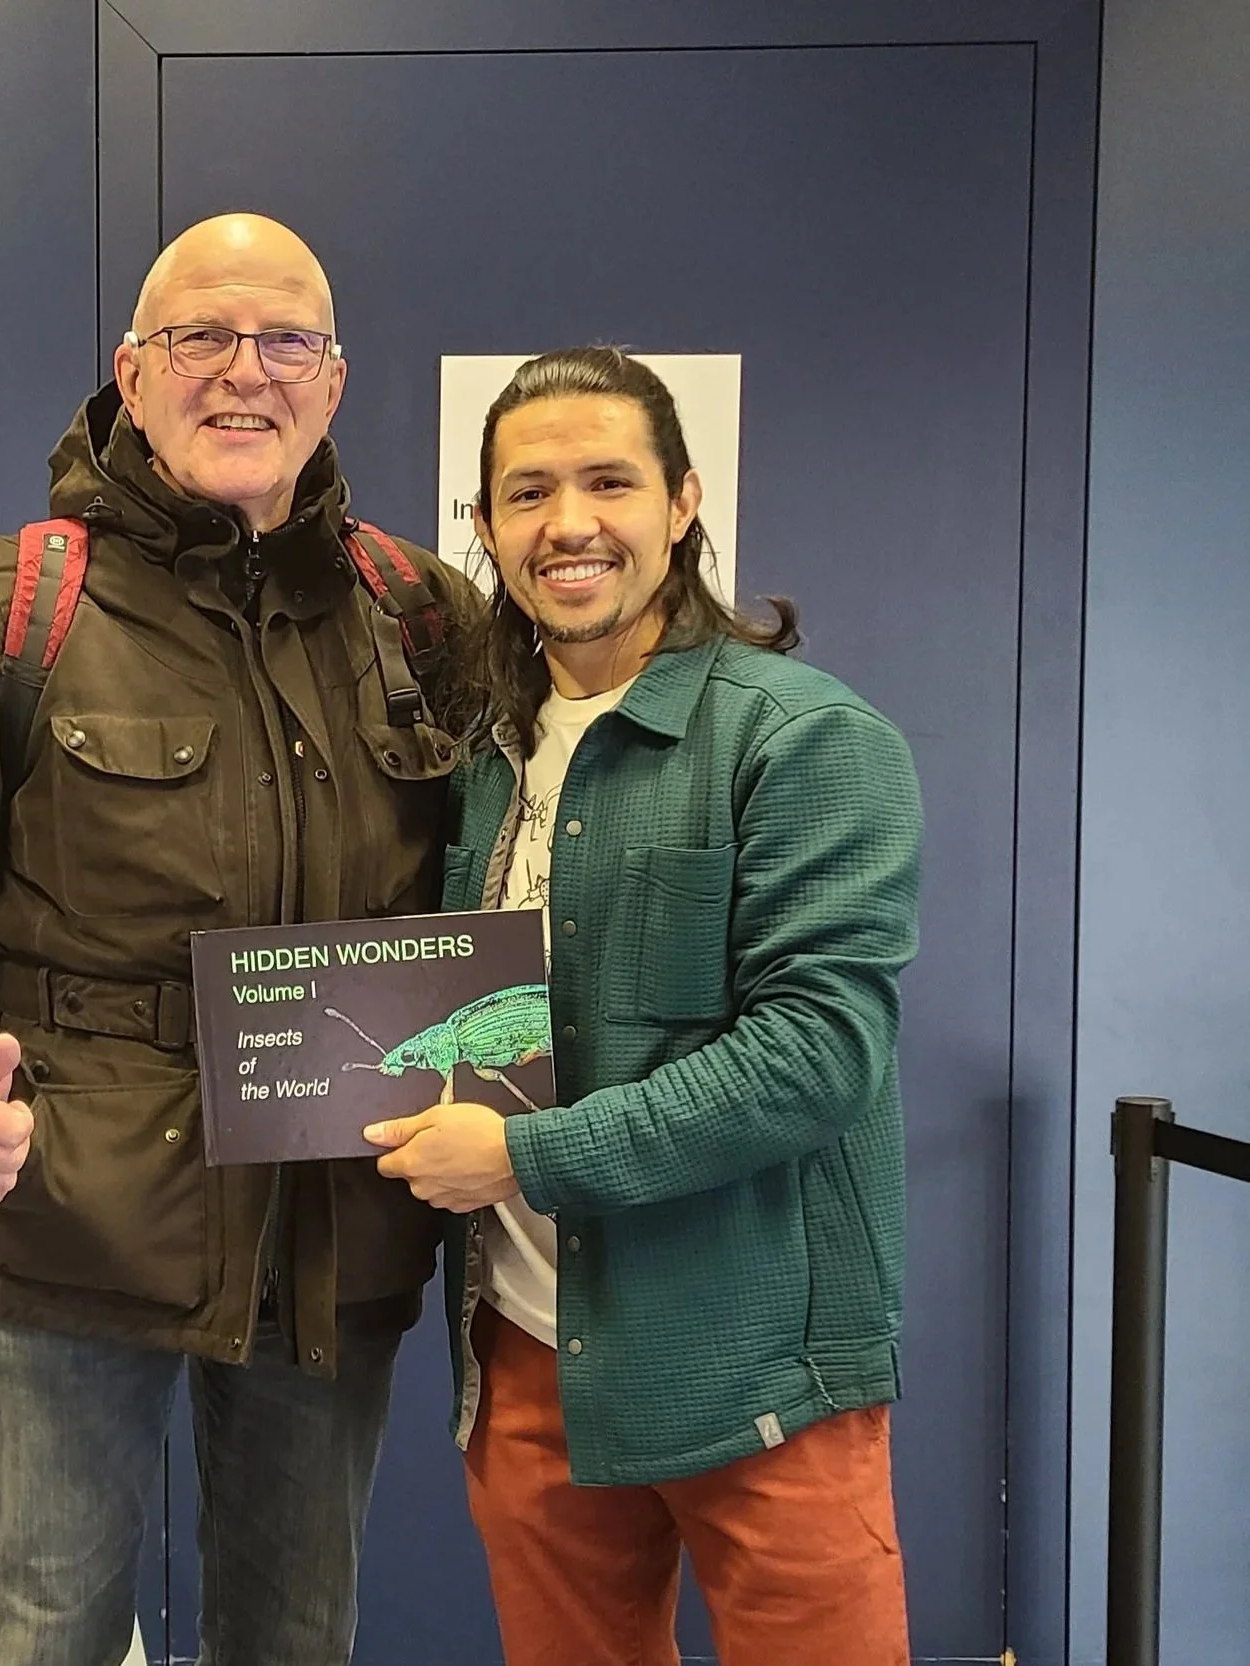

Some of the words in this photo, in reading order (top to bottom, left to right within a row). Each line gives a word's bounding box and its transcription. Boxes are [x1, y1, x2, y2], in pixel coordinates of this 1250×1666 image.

[231, 944, 329, 974] HIDDEN
[335, 934, 474, 966] WONDERS
[232, 983, 305, 1004] Volume
[310, 980, 317, 999] I
[237, 1028, 303, 1049] Insects
[238, 1056, 258, 1075] of
[240, 1082, 270, 1101] the
[275, 1077, 330, 1098] World
